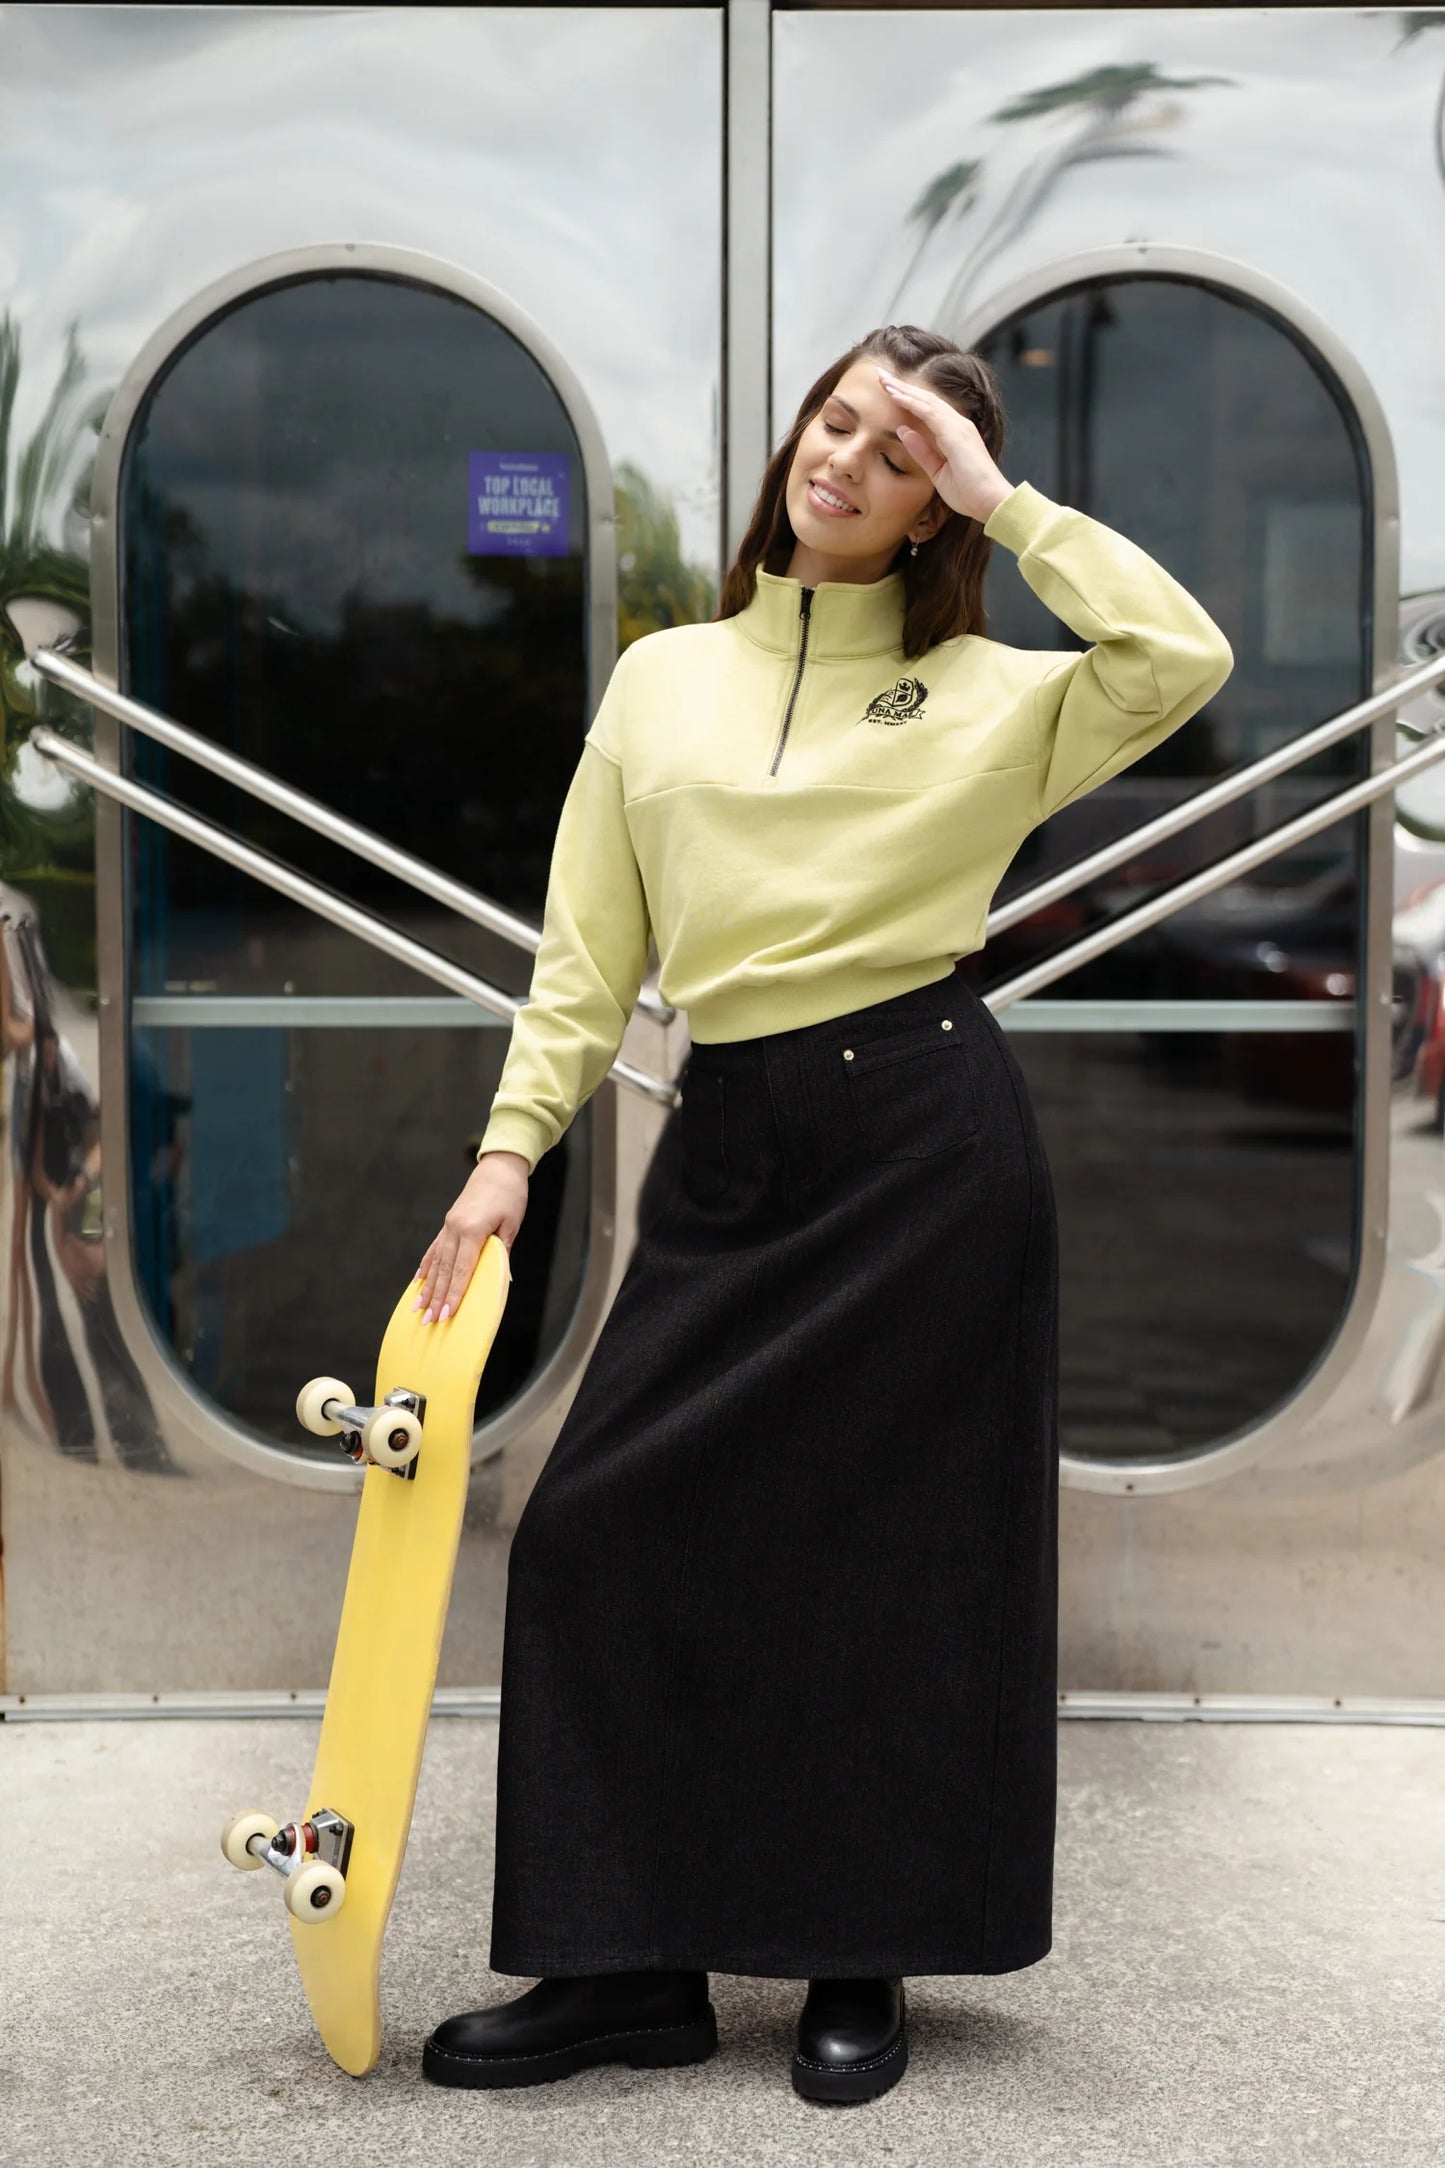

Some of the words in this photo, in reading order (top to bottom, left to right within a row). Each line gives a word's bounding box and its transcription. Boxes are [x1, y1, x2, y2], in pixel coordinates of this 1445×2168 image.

[484, 475, 510, 496] TOP
[512, 475, 553, 497] LOCAL
[478, 496, 560, 518] WORKPLACE
